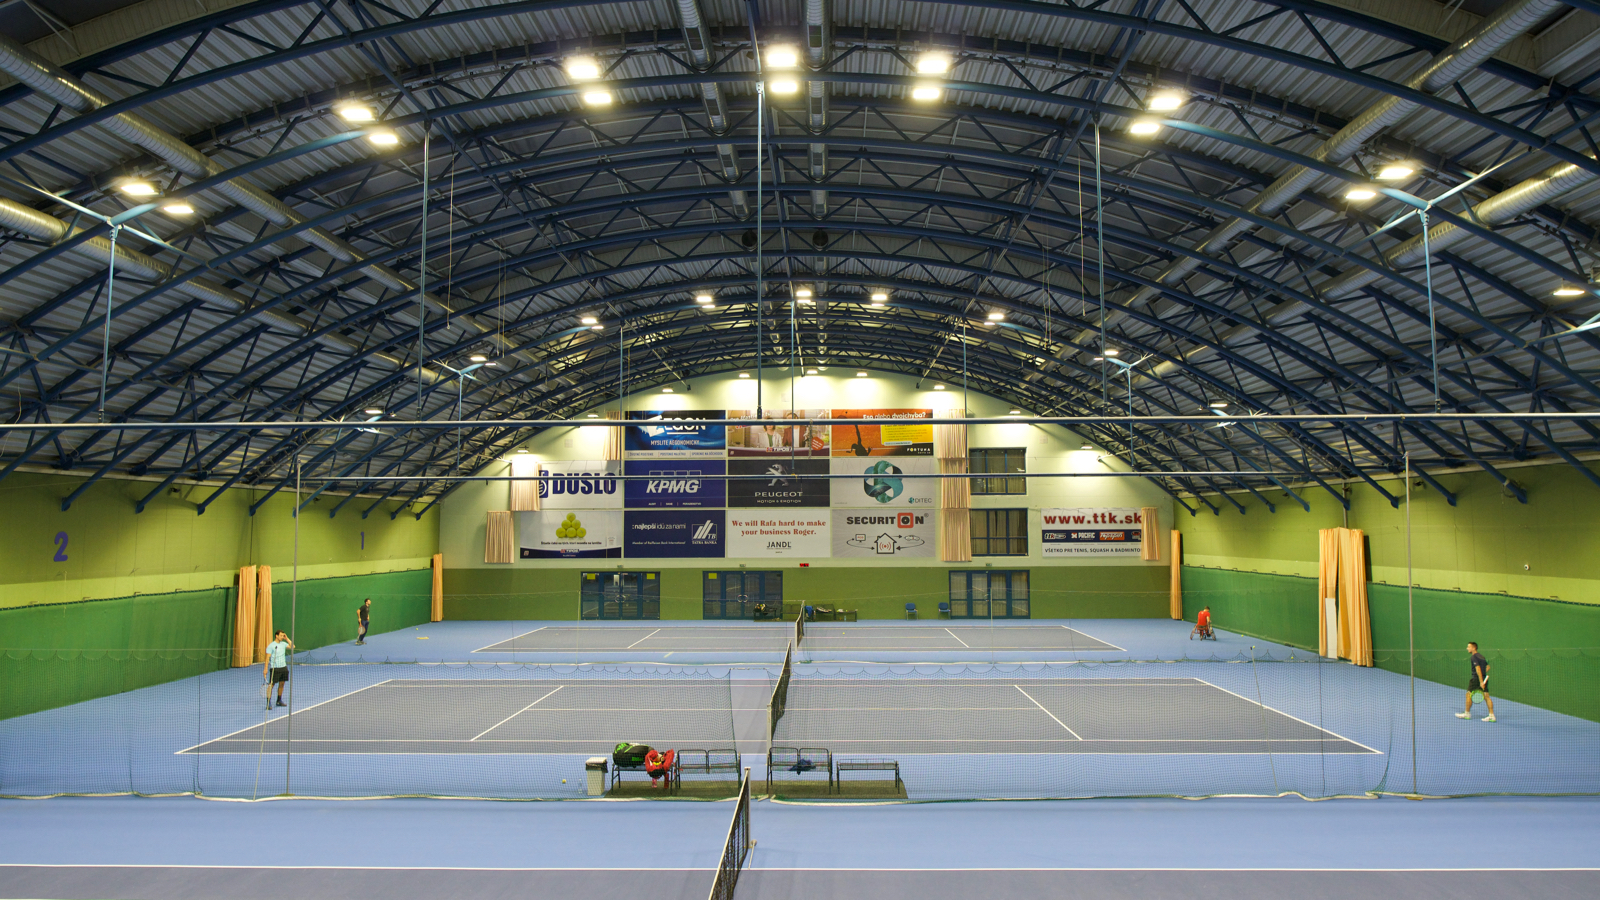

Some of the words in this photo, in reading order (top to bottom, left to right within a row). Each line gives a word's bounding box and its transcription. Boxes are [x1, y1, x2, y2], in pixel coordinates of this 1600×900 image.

[552, 473, 617, 495] DUSLO
[646, 479, 700, 493] KPMG
[1043, 512, 1142, 524] www.ttk.sk
[793, 528, 816, 536] Roger.
[53, 531, 69, 562] 2
[360, 531, 365, 550] 1
